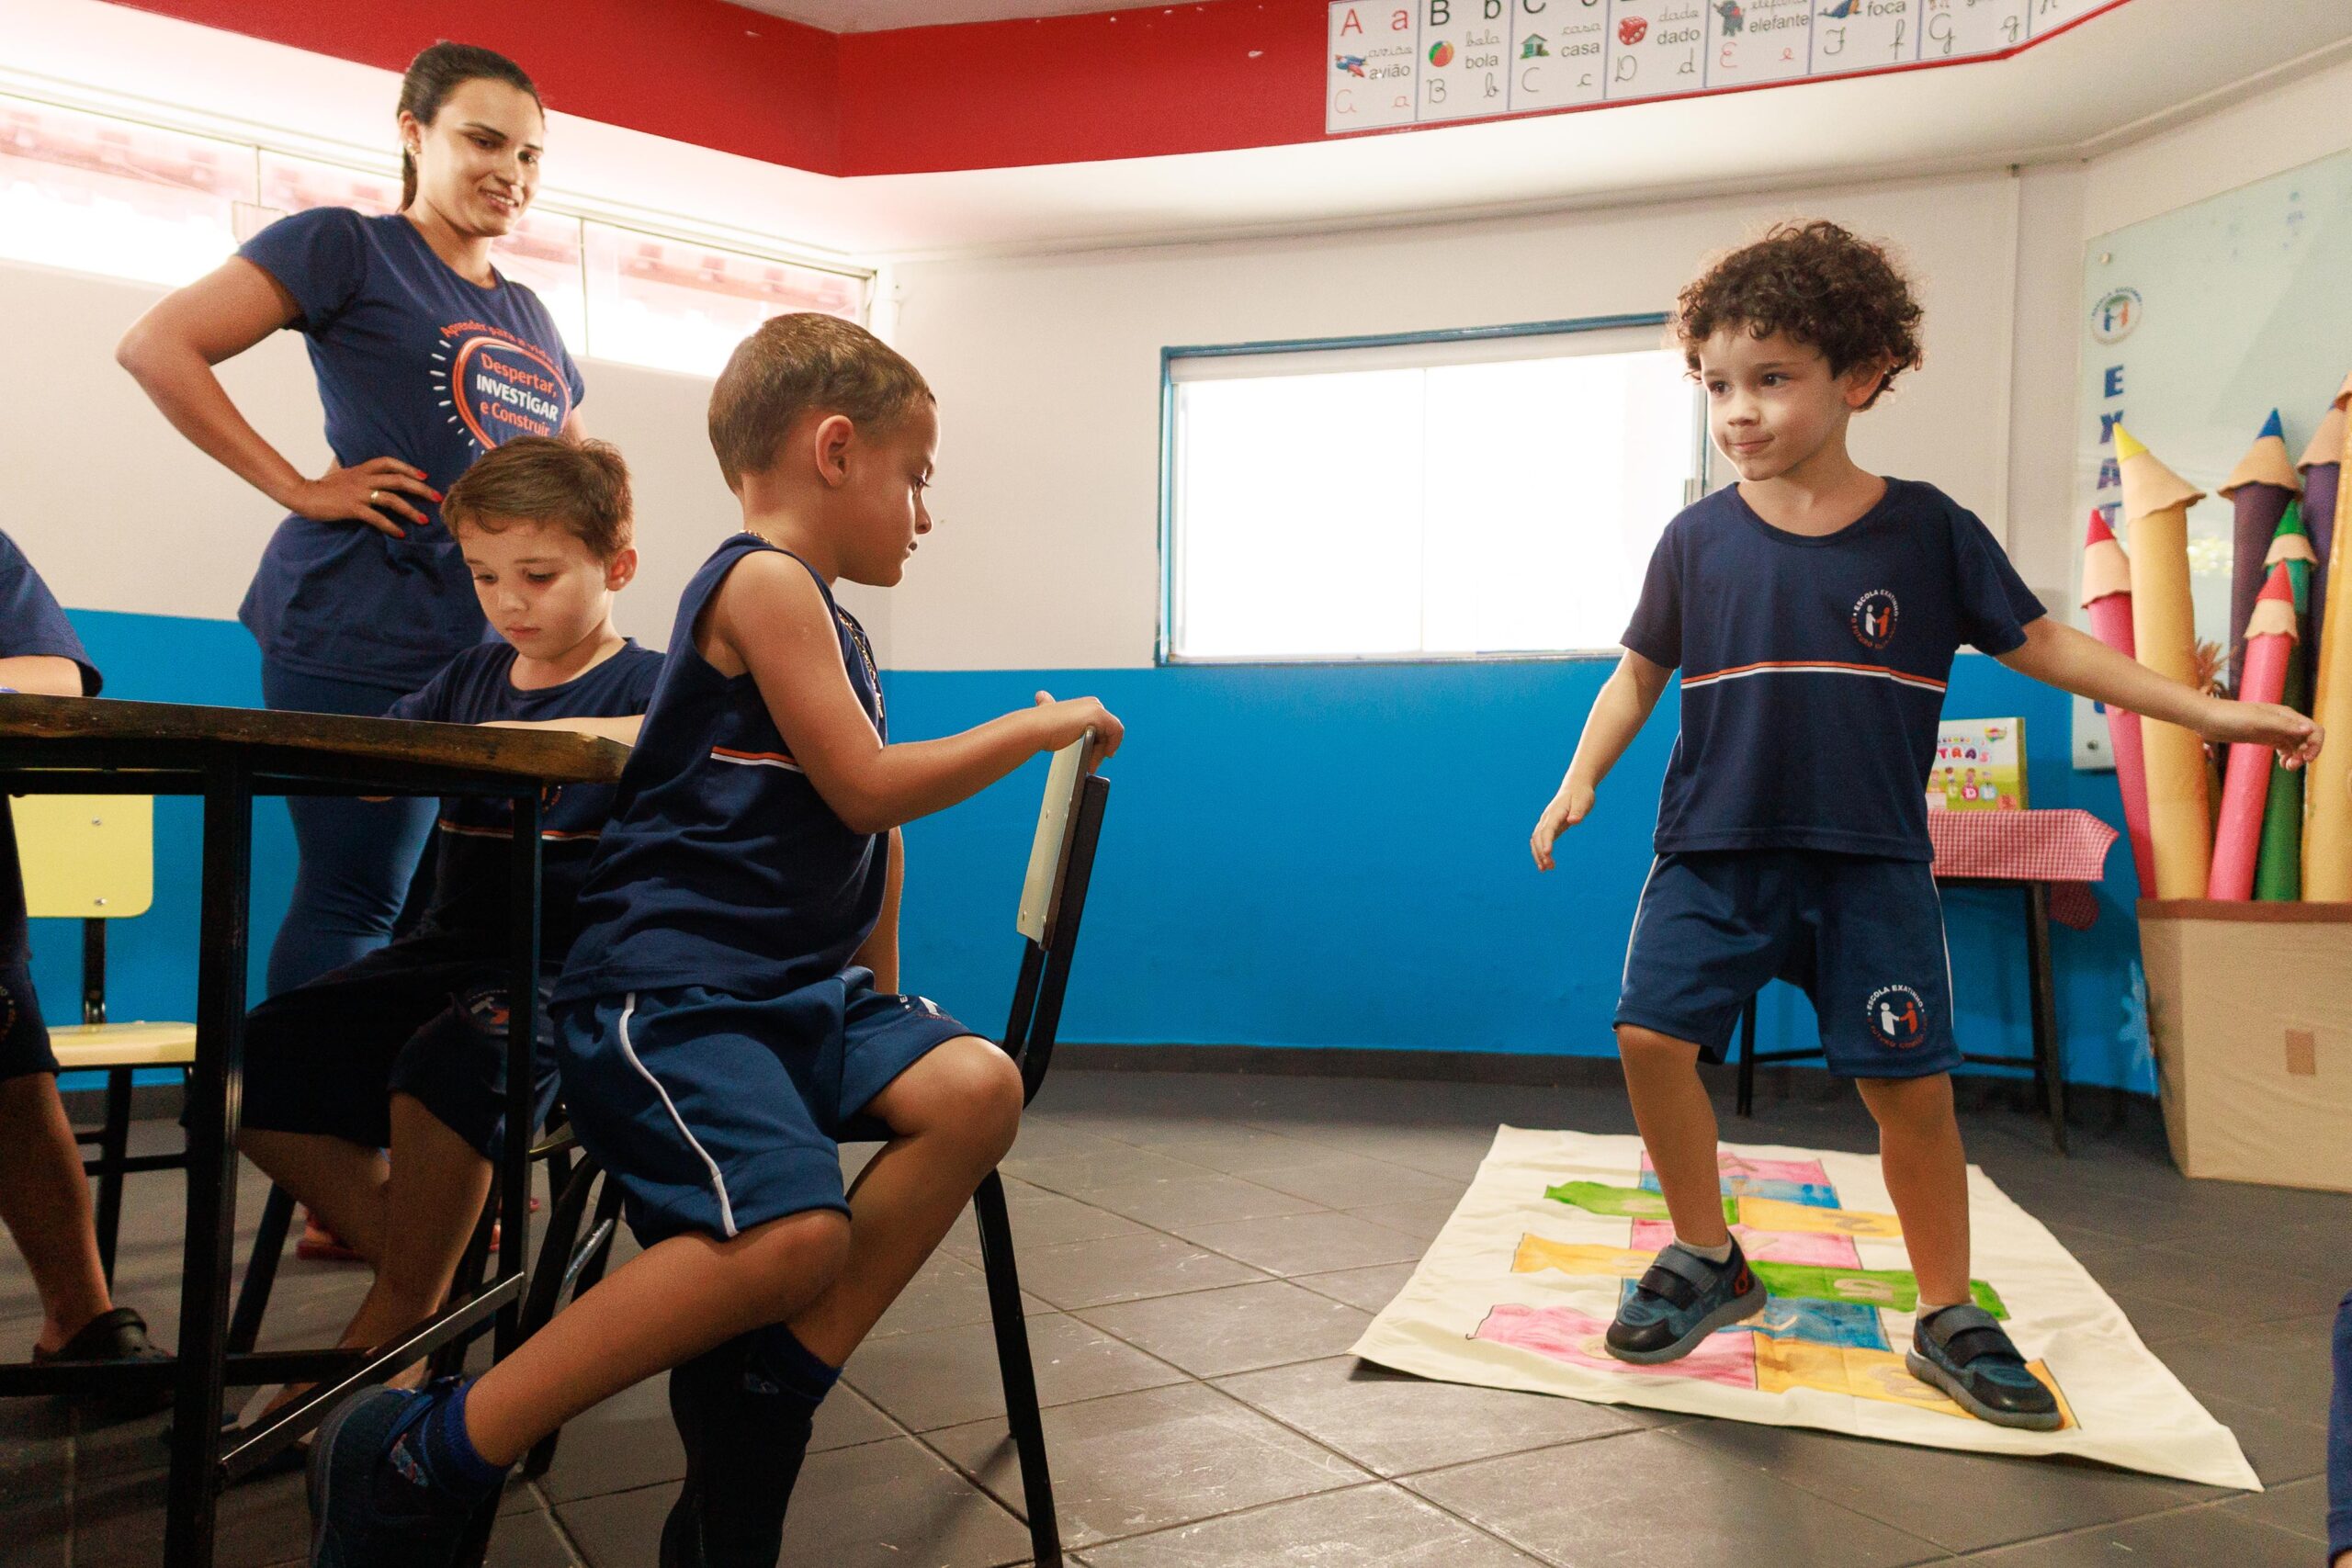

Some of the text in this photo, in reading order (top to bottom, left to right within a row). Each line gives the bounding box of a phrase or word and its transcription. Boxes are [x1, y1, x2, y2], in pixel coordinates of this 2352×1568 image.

[1430, 0, 1501, 27] B b
[1657, 2, 1700, 22] dado
[1868, 1, 1906, 17] foca
[1340, 8, 1408, 36] A a
[1562, 22, 1601, 36] casa
[1749, 14, 1809, 33] elefante
[1928, 13, 2020, 54] G g
[1464, 29, 1500, 47] bola
[1657, 28, 1701, 45] dado
[1889, 18, 1905, 61] f
[1561, 42, 1600, 57] casa
[1719, 41, 1794, 68] E e
[1369, 64, 1410, 80] avião
[1465, 54, 1498, 69] bola
[1614, 47, 1696, 83] D d
[1426, 72, 1500, 105] B b
[1521, 66, 1592, 93] C c
[1393, 95, 1410, 108] a
[481, 353, 558, 398] Despertar,
[480, 401, 550, 437] e Construir
[1854, 589, 1879, 612] ESCOLA
[1866, 986, 1891, 1010] ESCOLA
